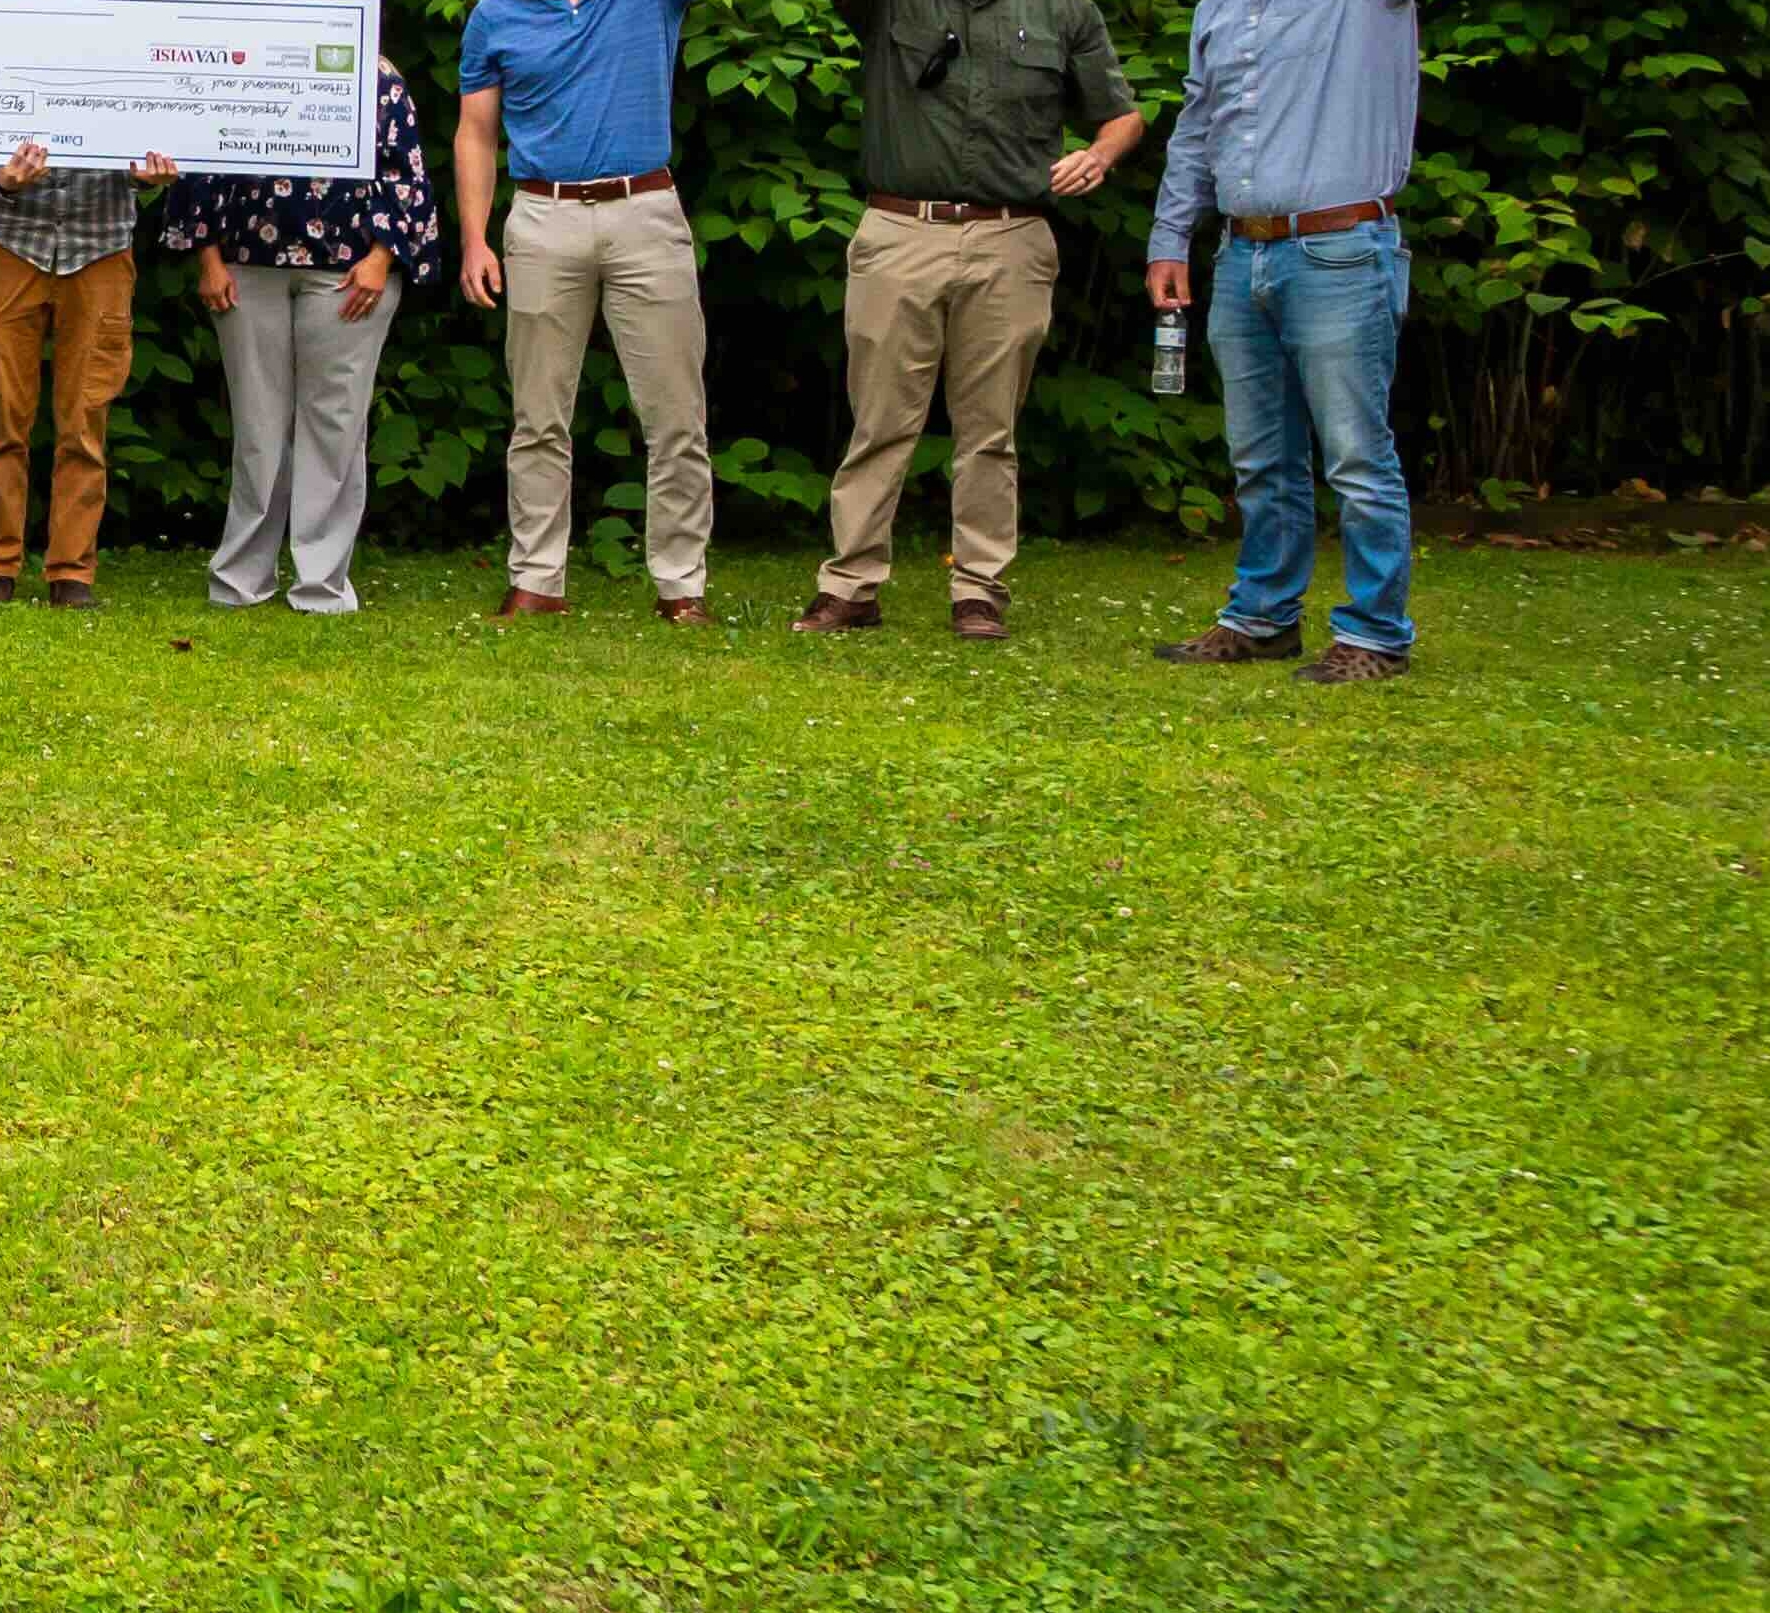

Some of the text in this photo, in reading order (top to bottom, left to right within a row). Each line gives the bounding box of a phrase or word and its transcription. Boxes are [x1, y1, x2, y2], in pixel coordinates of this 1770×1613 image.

[212, 79, 236, 90] and
[241, 80, 302, 94] Thousand
[309, 83, 350, 95] Fifteen
[45, 96, 288, 117] Appalachian Sustainable Development
[298, 112, 314, 120] THE
[51, 135, 82, 145] Date
[218, 140, 351, 156] Cumberland Forest
